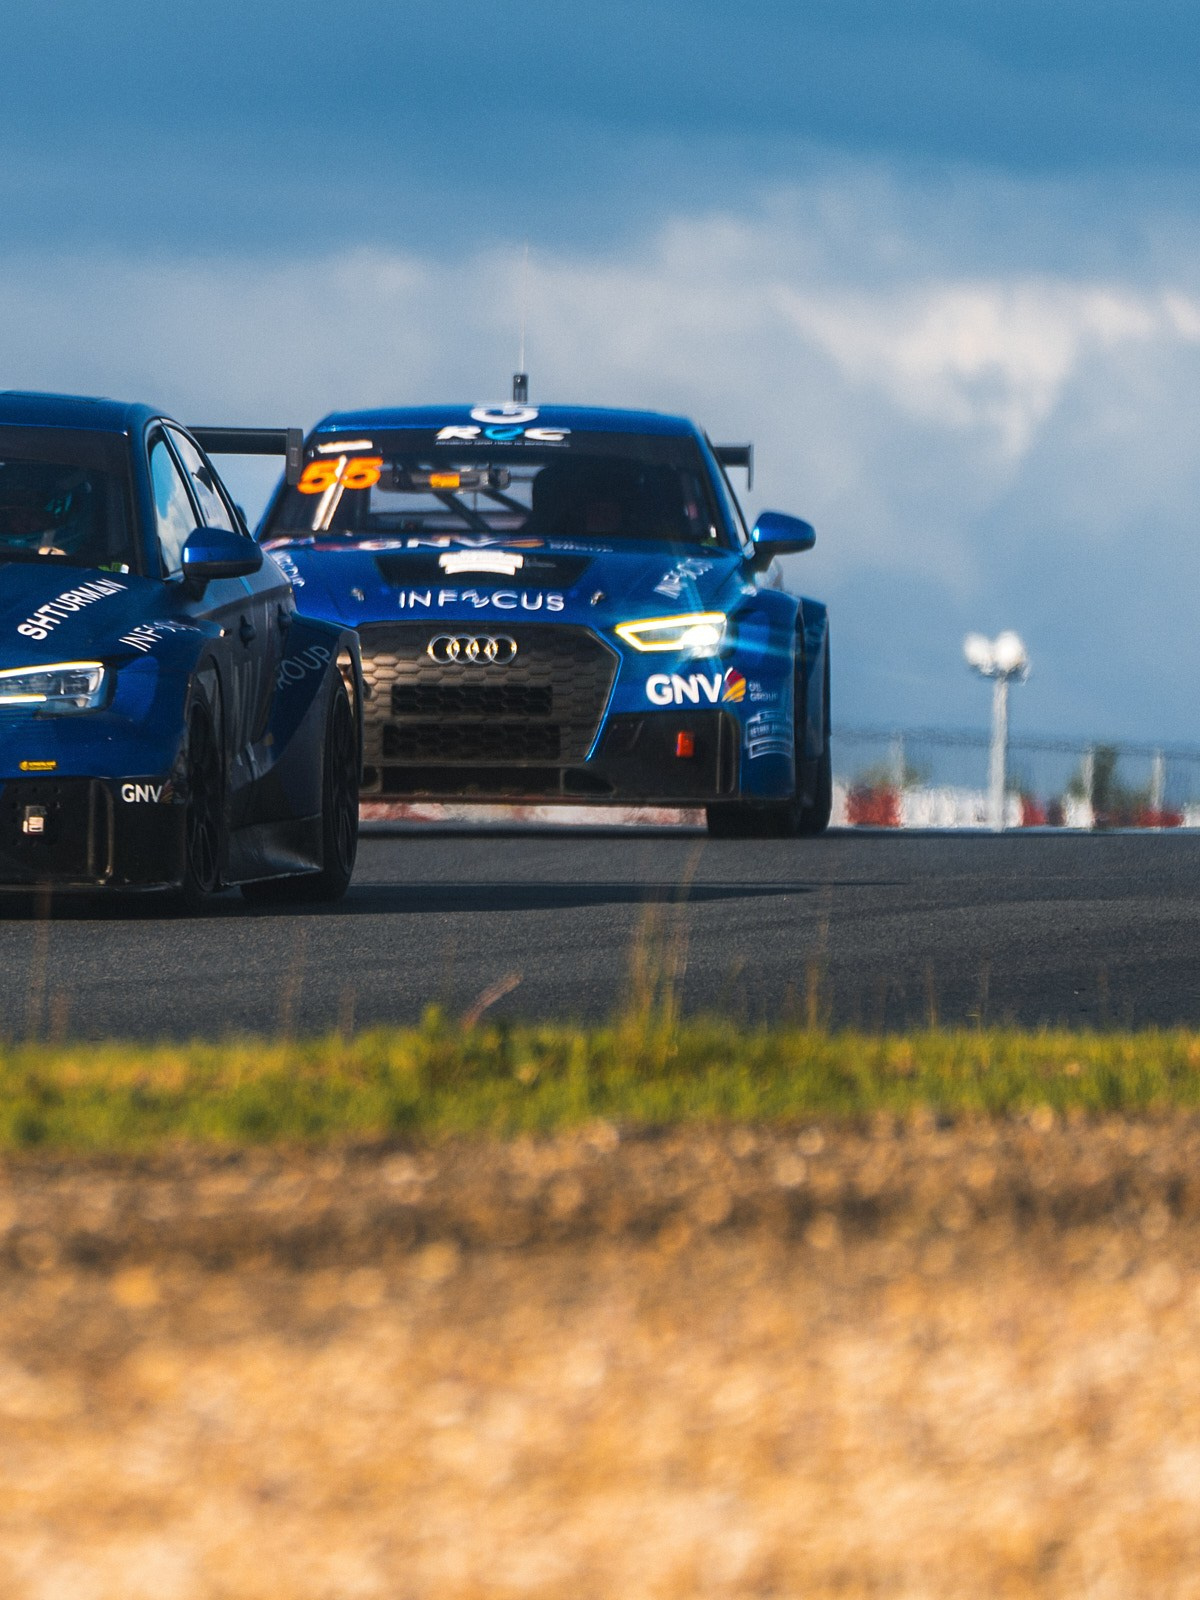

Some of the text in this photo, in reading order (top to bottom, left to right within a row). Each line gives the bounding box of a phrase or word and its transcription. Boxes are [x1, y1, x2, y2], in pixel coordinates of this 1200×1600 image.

[297, 456, 383, 495] 55
[17, 578, 129, 640] SHTURMAN
[646, 673, 723, 705] GNV
[121, 783, 163, 803] GNV
